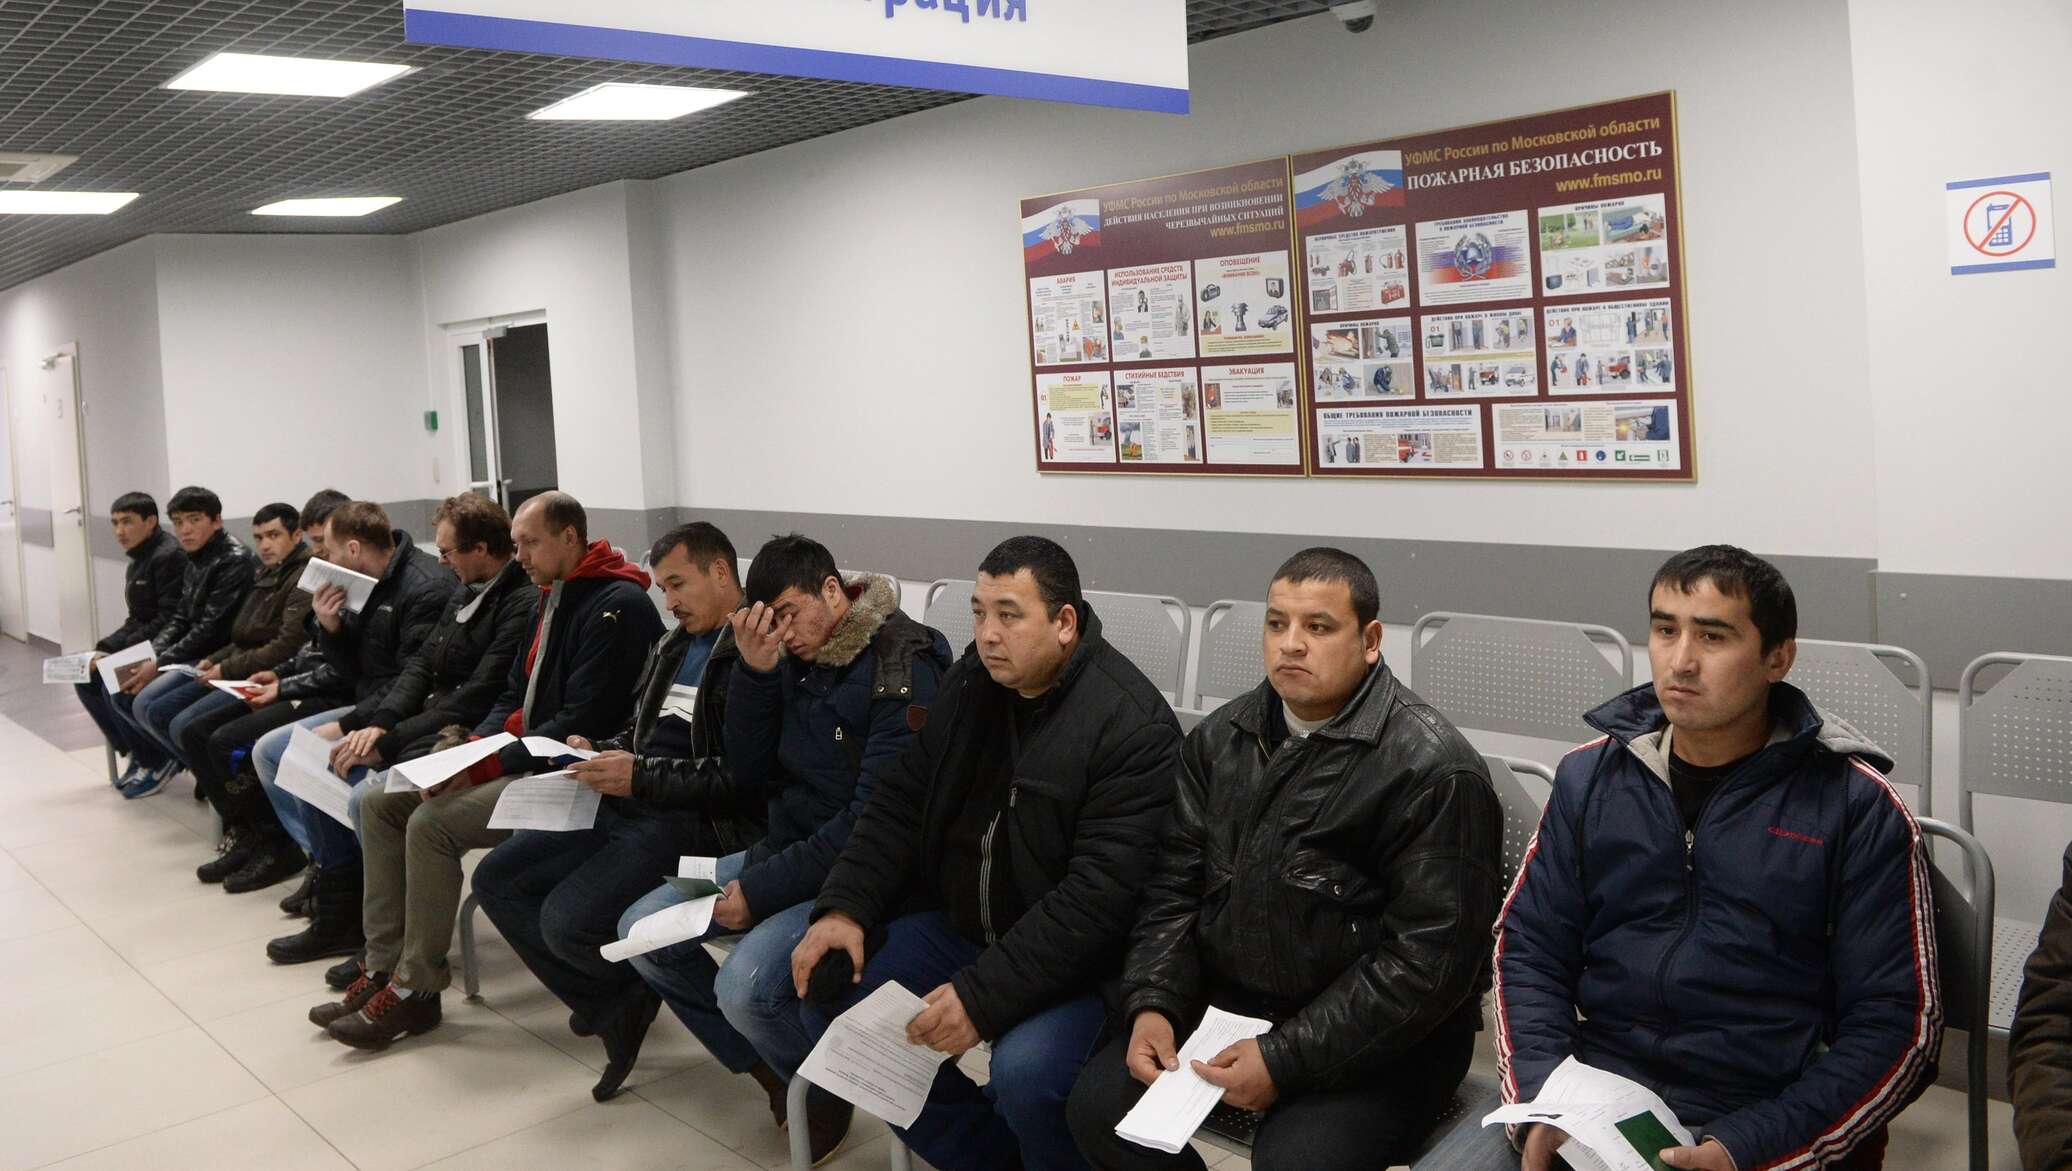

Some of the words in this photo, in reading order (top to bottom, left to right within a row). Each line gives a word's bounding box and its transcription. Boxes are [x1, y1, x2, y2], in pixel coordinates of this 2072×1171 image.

[886, 0, 1027, 23] ция
[1405, 149, 1440, 166] УФМС
[1444, 144, 1489, 159] России
[1492, 141, 1508, 153] по
[1512, 125, 1597, 150] Московской
[1600, 118, 1660, 136] области
[1407, 162, 1504, 190] ПОЖАРНАЯ
[1510, 141, 1662, 176] БЕЗОПАСНОСТЬ
[1556, 168, 1662, 192] www.fmsmo.ru
[1103, 198, 1129, 212] УФМС
[1131, 195, 1163, 209] России
[1165, 192, 1177, 204] по
[1179, 181, 1239, 201] Московской
[1241, 176, 1283, 192] области
[1104, 213, 1142, 228] ДЕЙСТВИЯ
[1144, 206, 1190, 220] НАСЕЛЕНИЯ
[1192, 203, 1207, 214] ПРИ
[1209, 193, 1283, 212] ВОЗНИКНОВЕНИИ
[1238, 205, 1284, 221] СИТУАЦИЙ
[1210, 220, 1284, 238] www.fmsmo.ru
